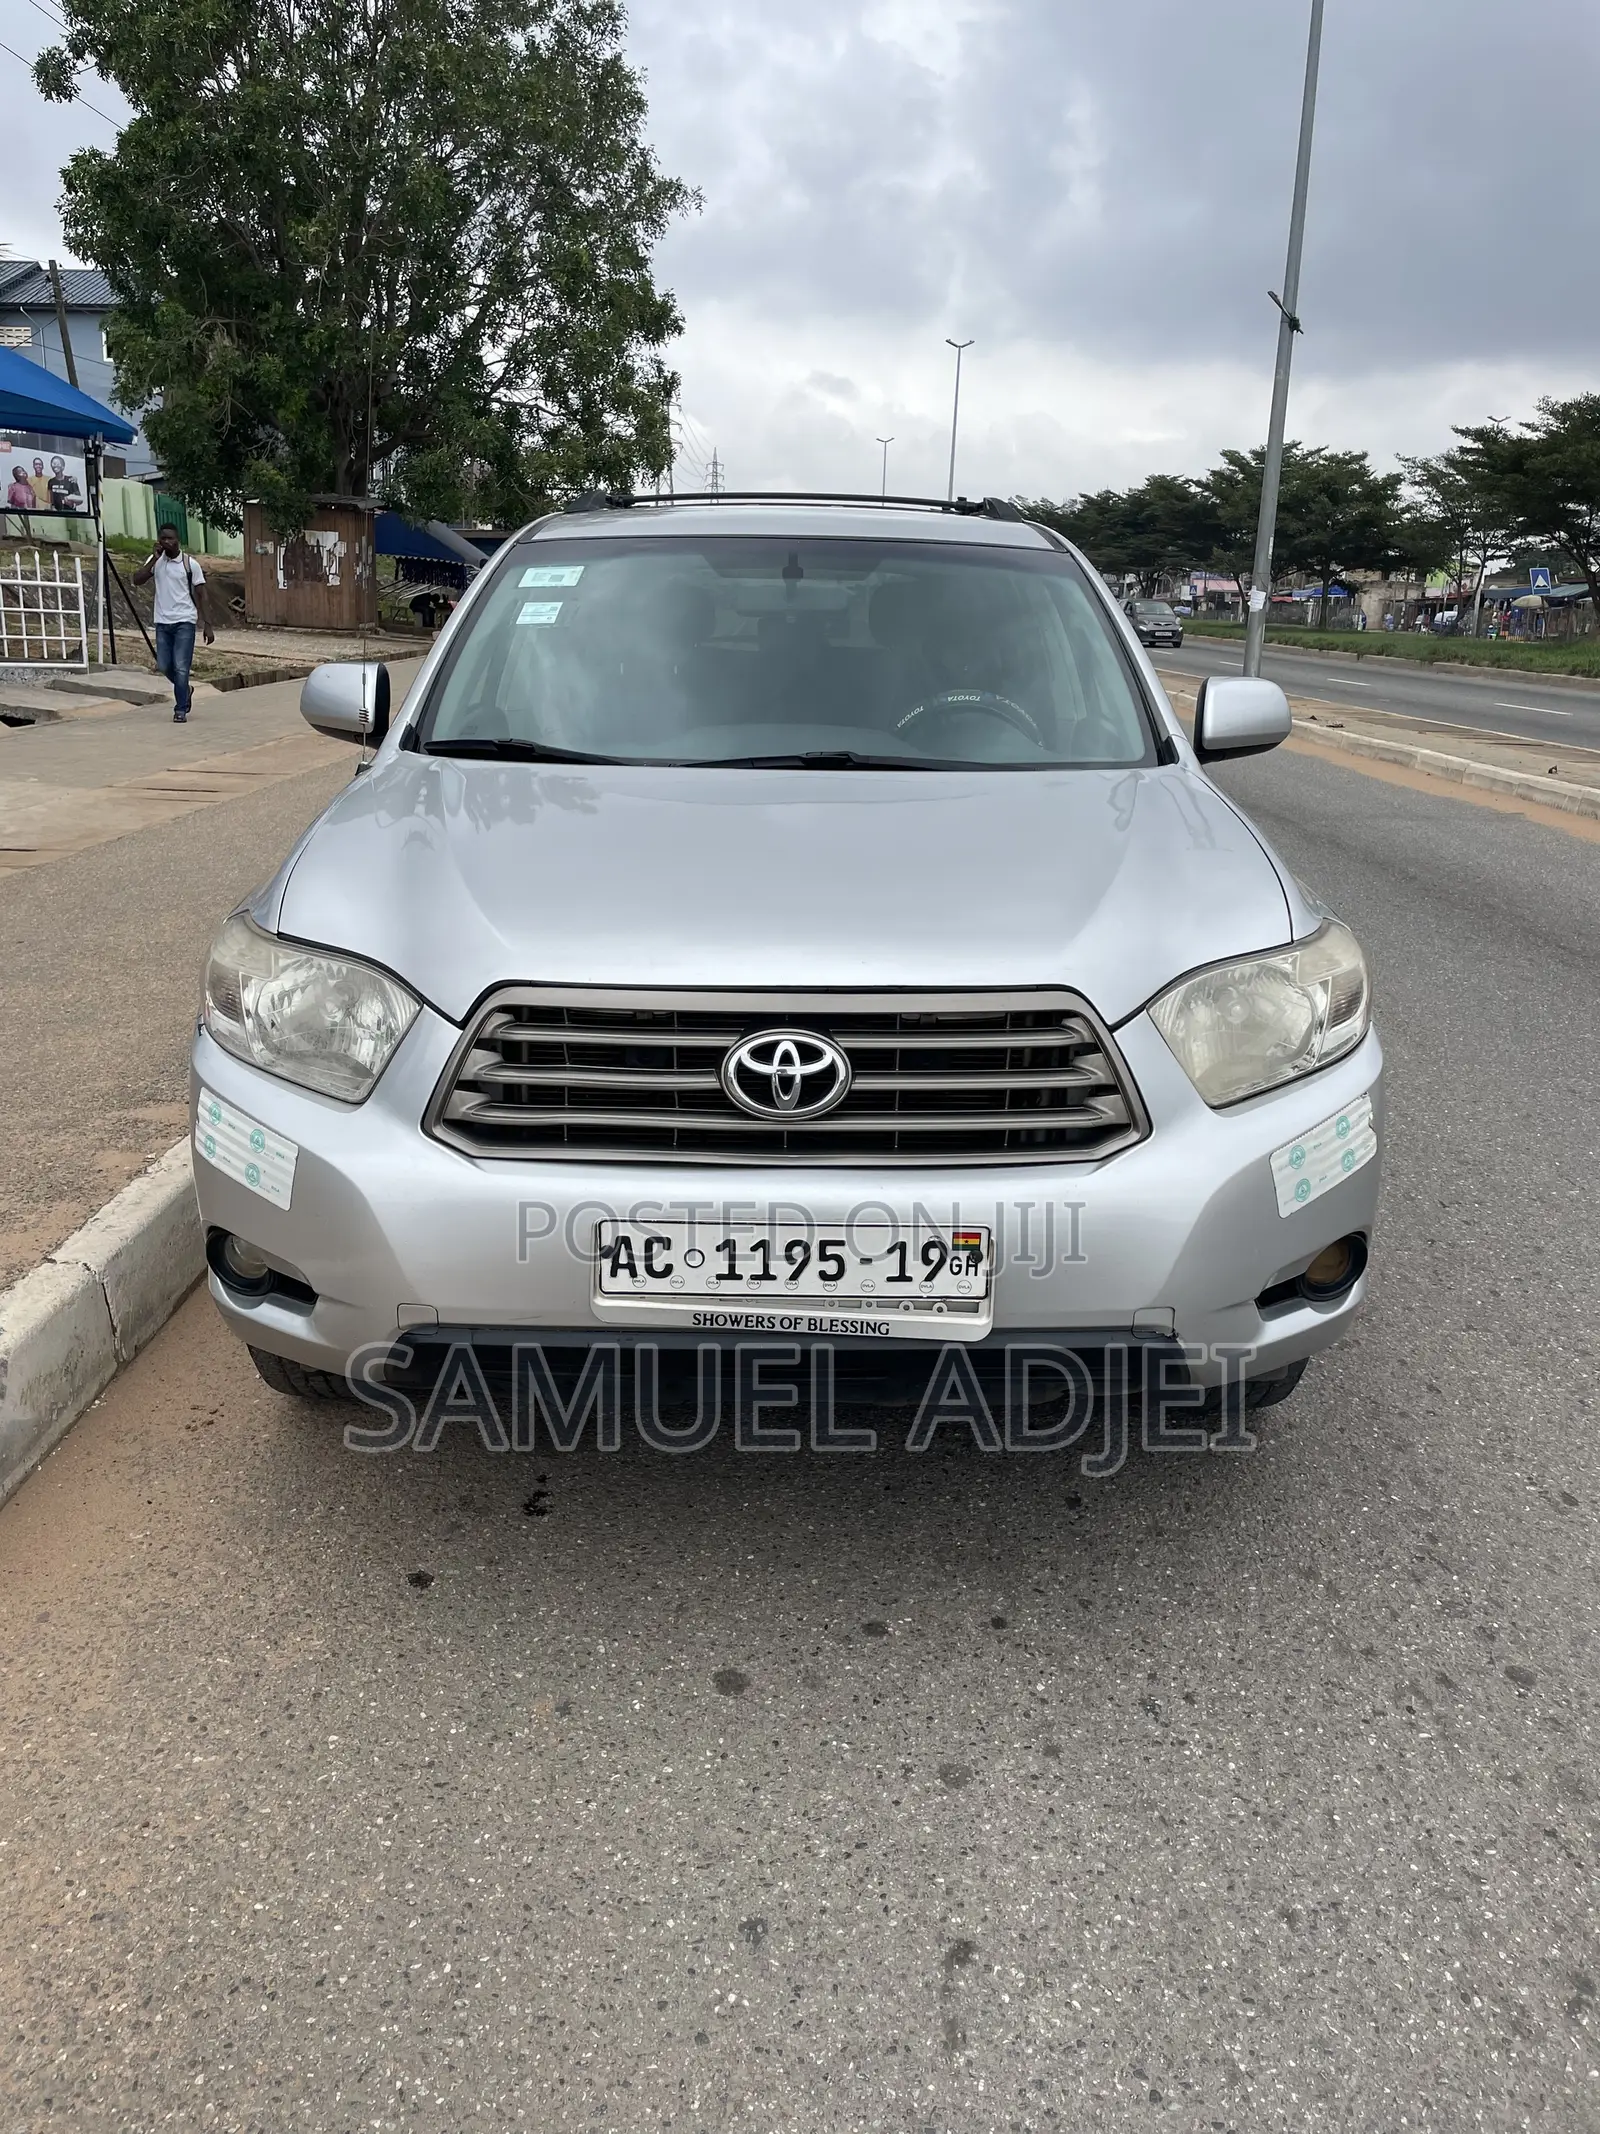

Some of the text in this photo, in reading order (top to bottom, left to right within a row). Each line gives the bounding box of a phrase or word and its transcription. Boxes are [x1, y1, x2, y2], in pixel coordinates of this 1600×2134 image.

[947, 694, 982, 702] TOYOTA
[609, 1235, 674, 1279] AC
[692, 1312, 890, 1336] SHOWERS OF BLESSING
